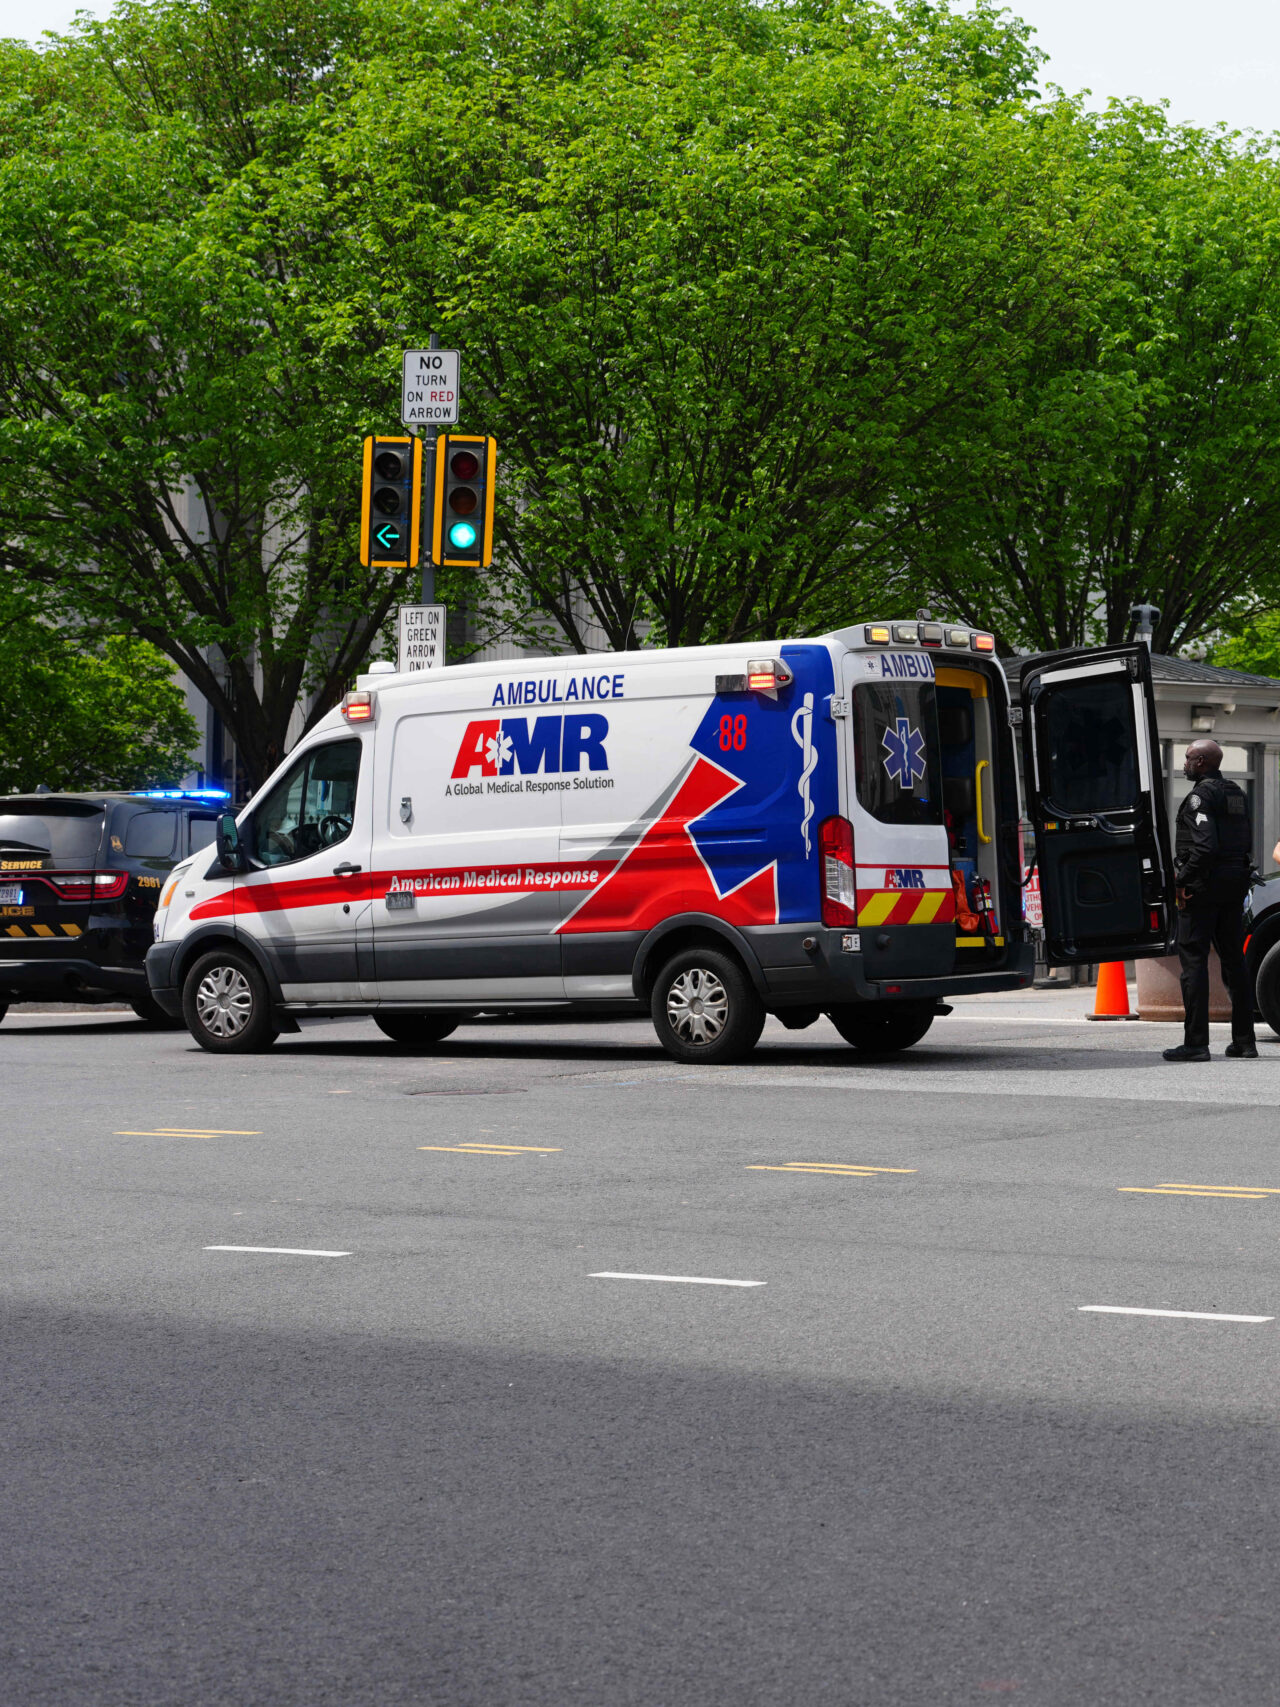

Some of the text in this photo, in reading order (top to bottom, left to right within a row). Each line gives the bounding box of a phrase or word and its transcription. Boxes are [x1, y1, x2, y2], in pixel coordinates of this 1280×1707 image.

[420, 356, 443, 369] NO
[416, 375, 447, 386] TURN
[407, 391, 454, 402] ON RED
[409, 407, 452, 418] ARROW
[405, 611, 440, 625] LEFT ON
[408, 628, 437, 642] GREEN
[407, 644, 436, 658] ARROW
[881, 654, 936, 678] AMBUL
[492, 674, 625, 706] AMBULANCE
[719, 714, 747, 752] 88
[451, 713, 609, 779] AMR
[445, 776, 614, 797] A Global Medical Response Solution
[1, 860, 43, 870] SERVICE
[138, 876, 160, 888] 2981
[390, 868, 599, 892] American Medical Response
[884, 869, 926, 889] AMR
[1025, 875, 1040, 890] ST
